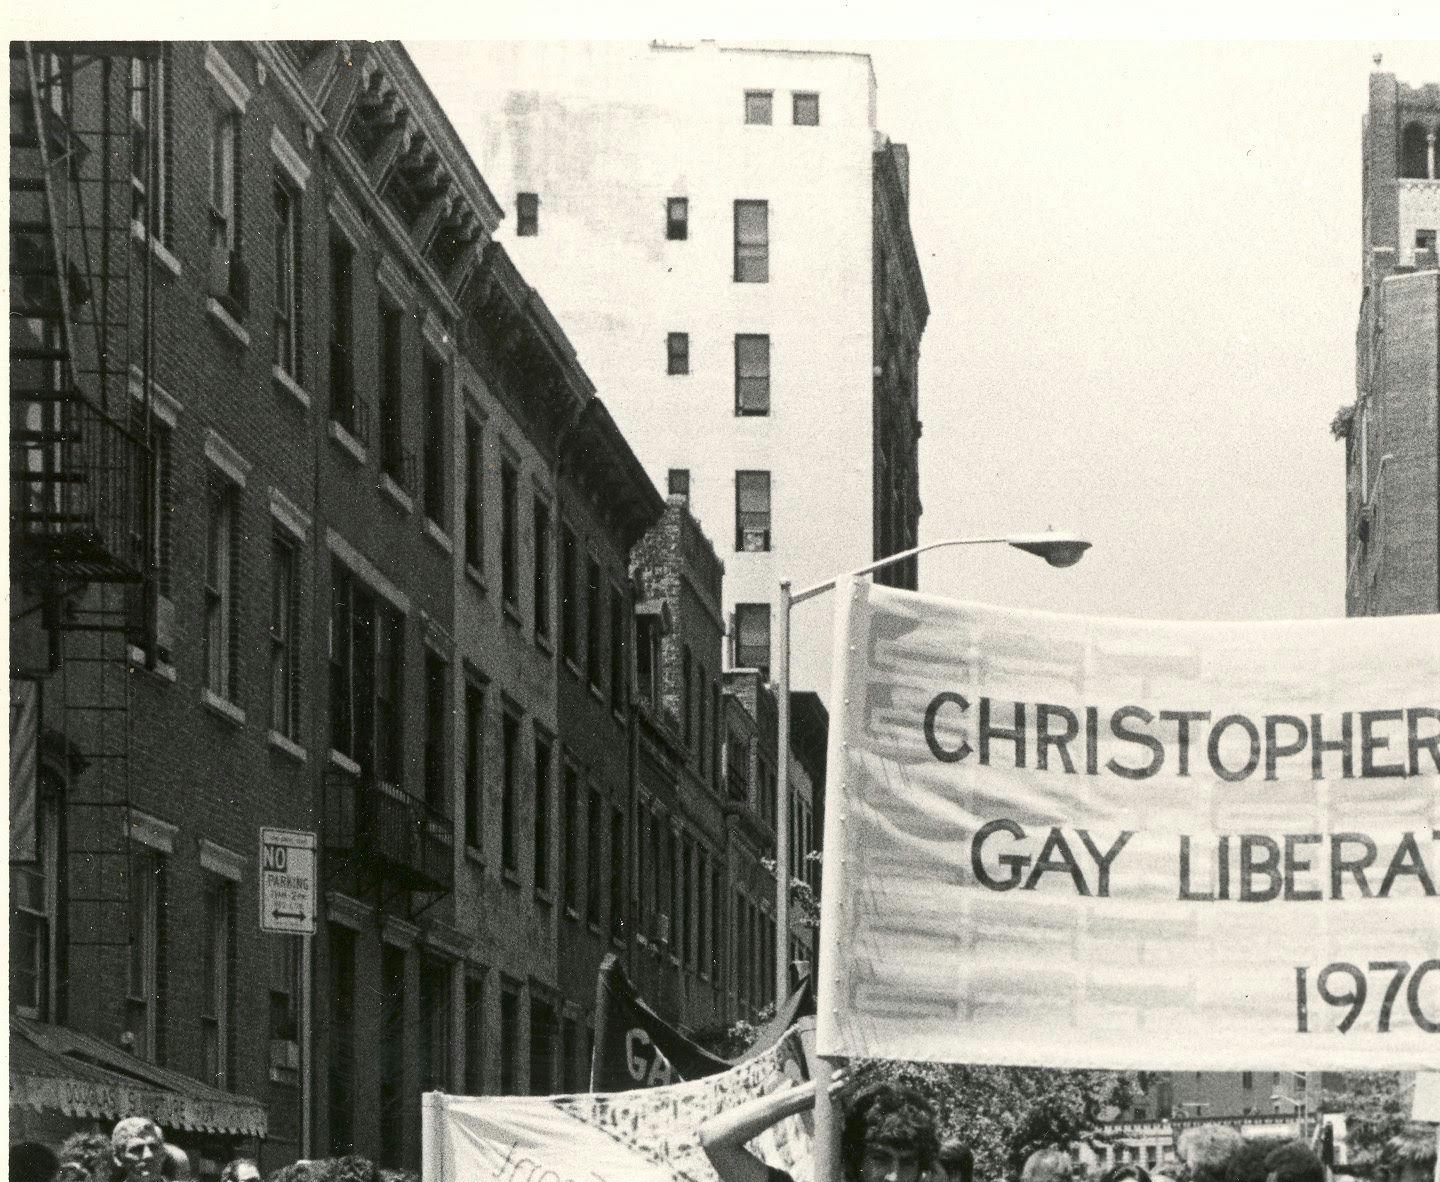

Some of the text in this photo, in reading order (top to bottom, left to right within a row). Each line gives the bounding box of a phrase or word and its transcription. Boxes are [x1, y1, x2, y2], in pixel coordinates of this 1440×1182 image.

[264, 846, 286, 870] NO
[971, 818, 1136, 898] GAY
[268, 874, 309, 891] PARKING
